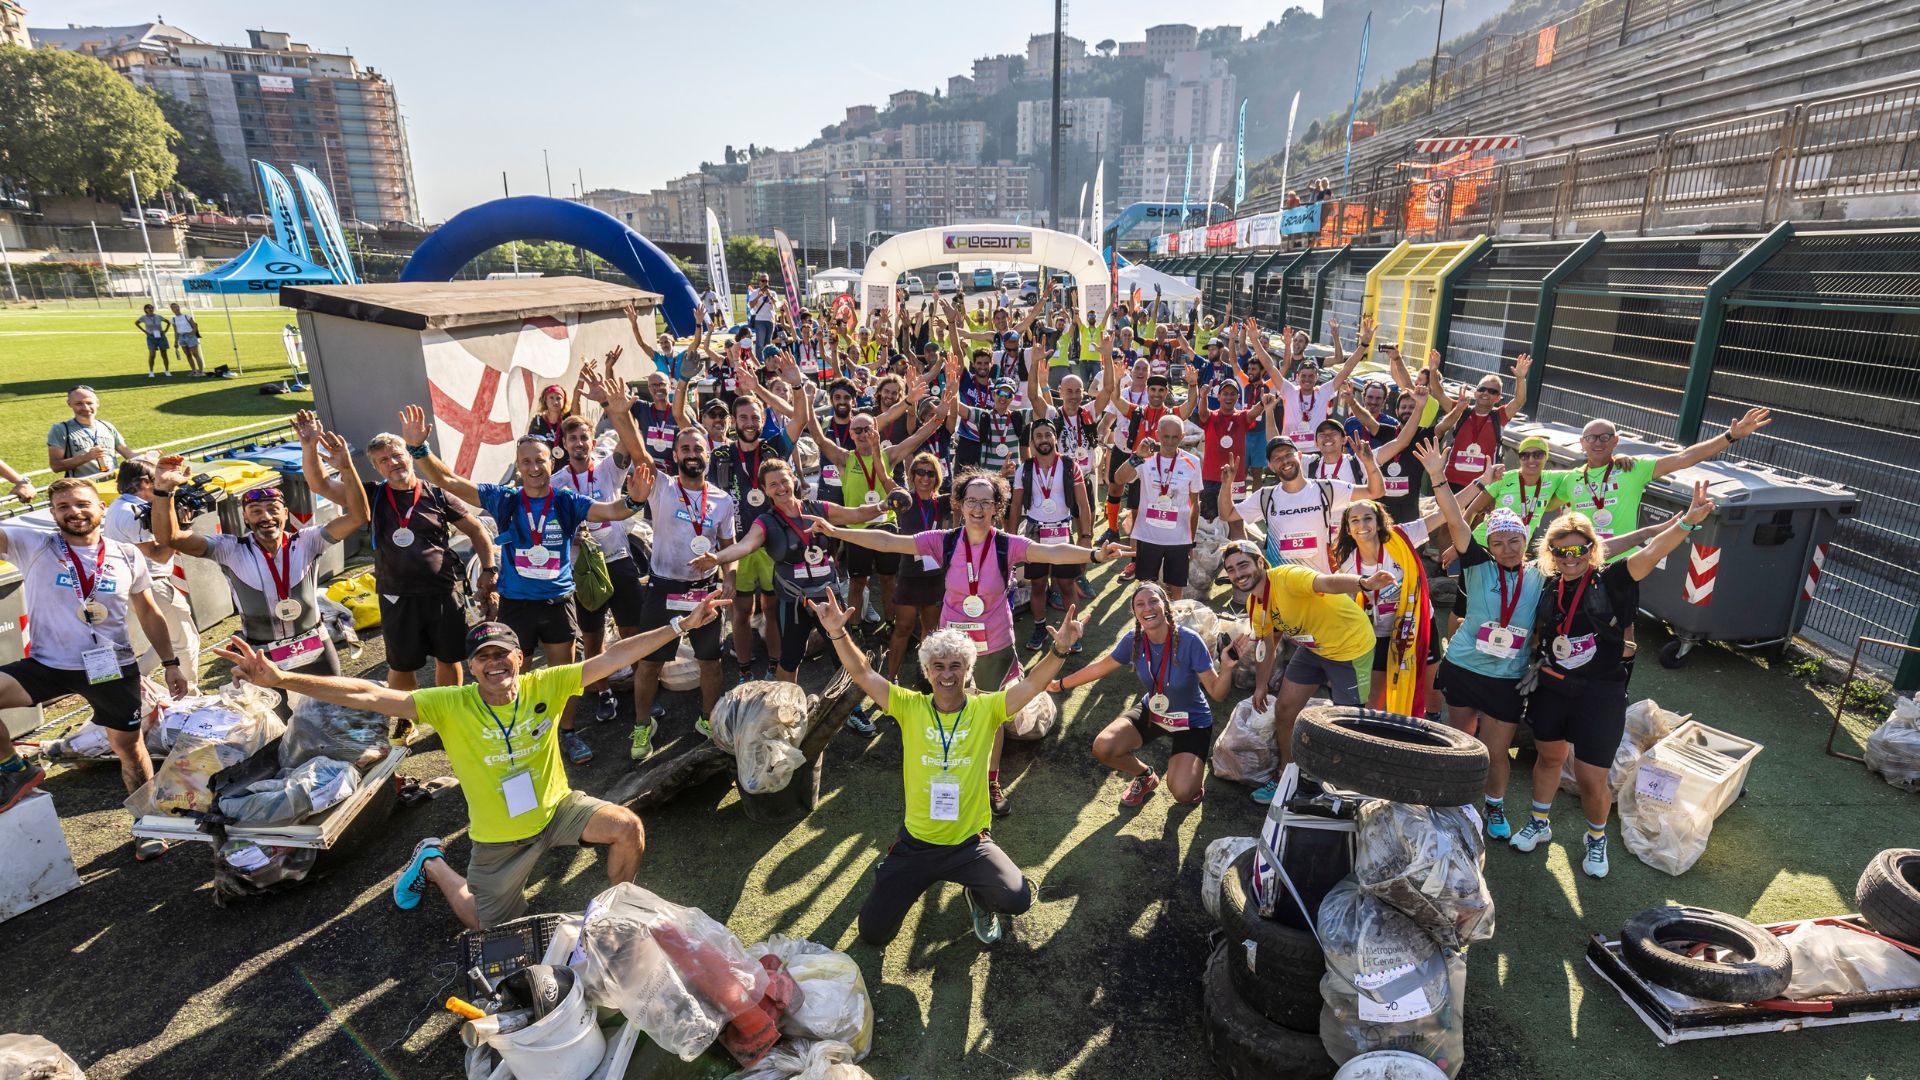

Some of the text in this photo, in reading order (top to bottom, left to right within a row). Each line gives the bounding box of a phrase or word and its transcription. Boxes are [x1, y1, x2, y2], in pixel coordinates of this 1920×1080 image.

[957, 236, 1030, 248] PLOGGING
[189, 280, 213, 290] SCARPA
[1279, 506, 1321, 515] SCARPA
[1292, 538, 1304, 547] 82
[681, 591, 694, 600] 42
[290, 642, 305, 654] 34
[482, 717, 535, 740] STAFF
[925, 725, 971, 743] STAFF
